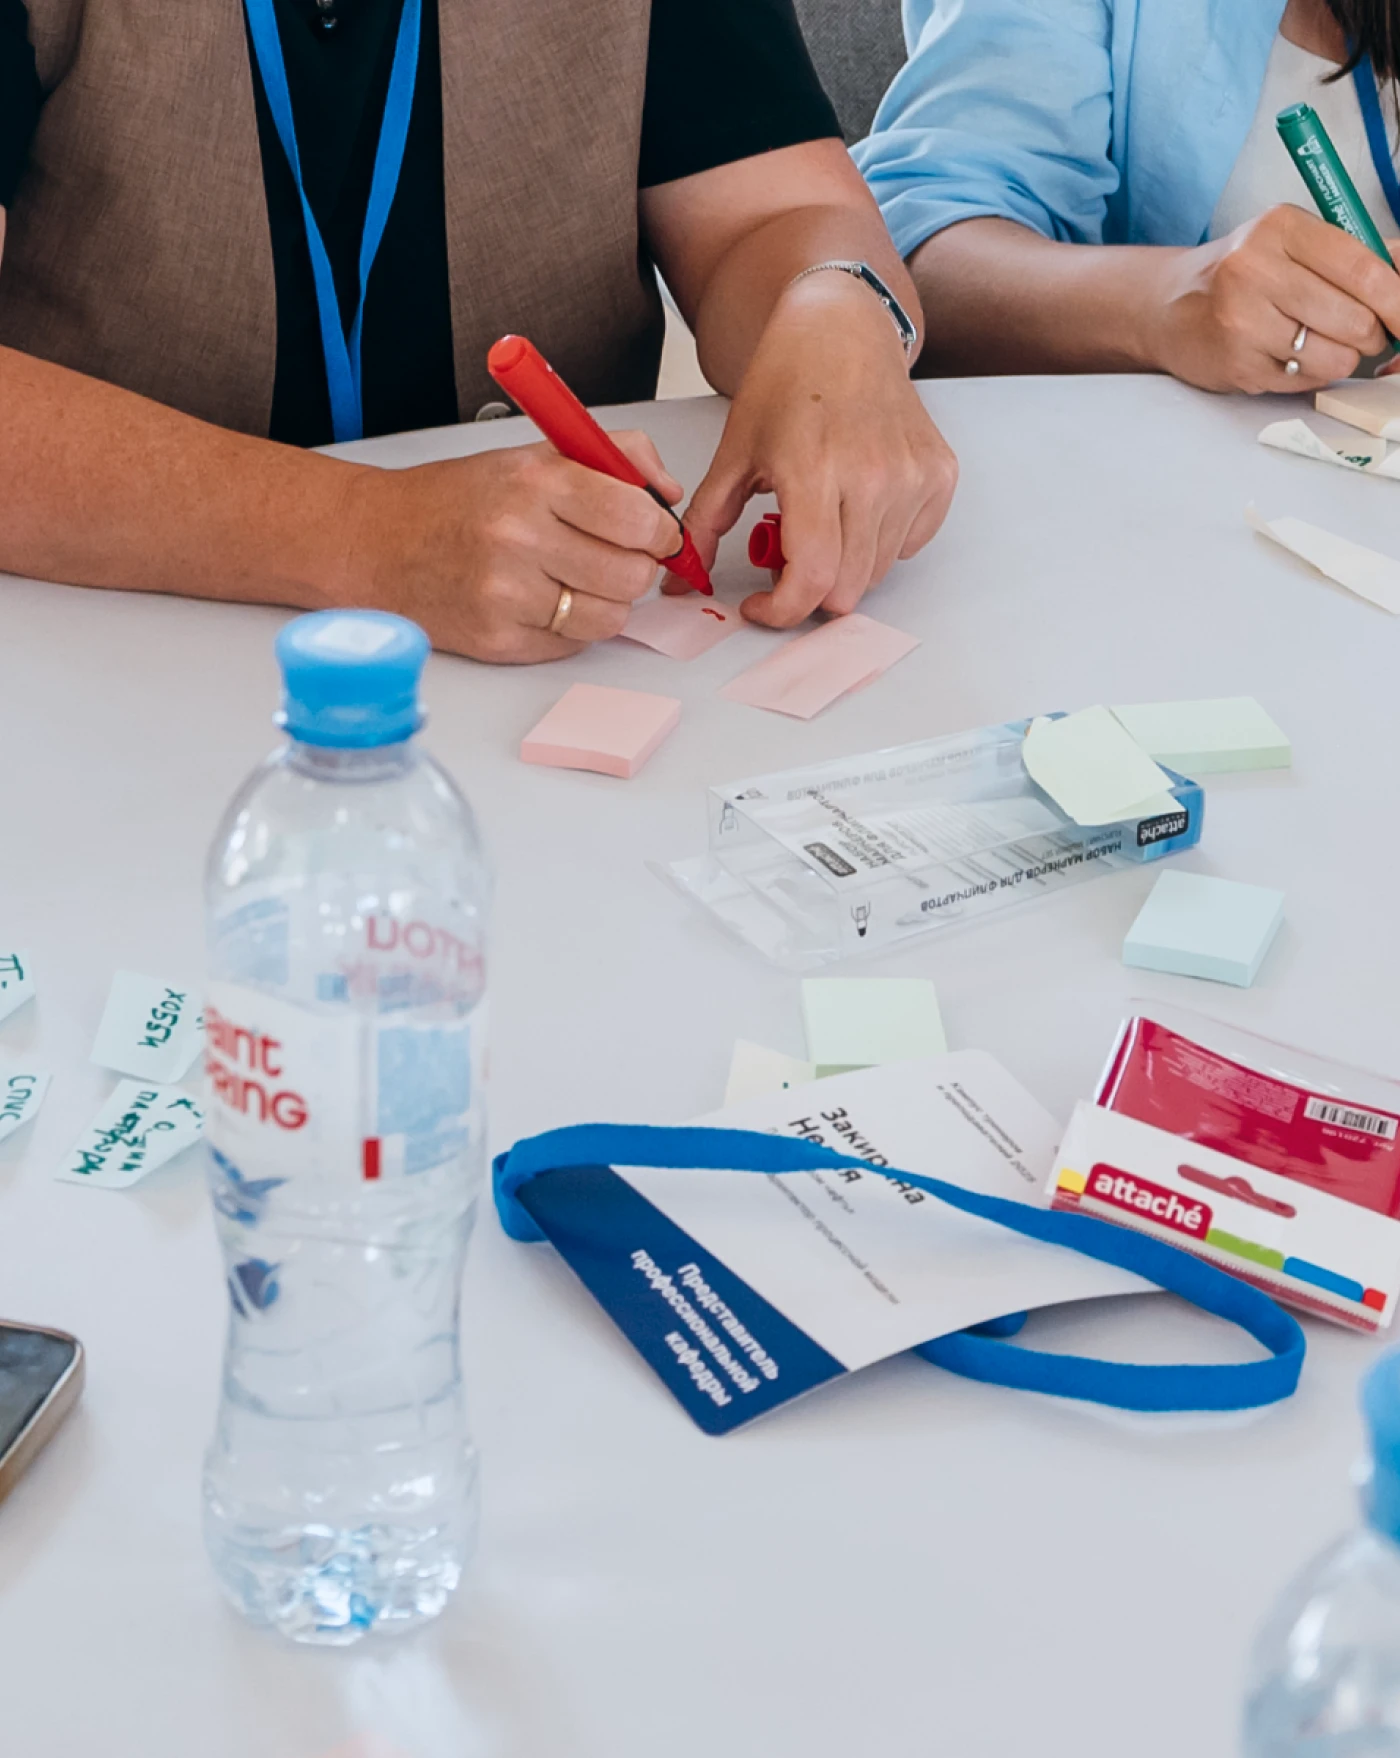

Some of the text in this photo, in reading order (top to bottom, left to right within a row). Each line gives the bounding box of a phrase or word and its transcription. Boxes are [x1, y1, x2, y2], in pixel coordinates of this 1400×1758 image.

[1330, 203, 1359, 237] aché
[1140, 819, 1184, 843] attaché
[921, 841, 1121, 913] НАБОР МАРКЕРОВ ДЛЯ ФЛИПЧАРТОВ
[205, 1006, 281, 1078] aint
[819, 1105, 928, 1207] Закирна
[765, 1173, 816, 1221] рхитектор
[1093, 1170, 1203, 1230] attaché
[630, 1250, 761, 1395] профессиональной
[676, 1262, 780, 1382] Представитель
[663, 1331, 733, 1408] кафедры
